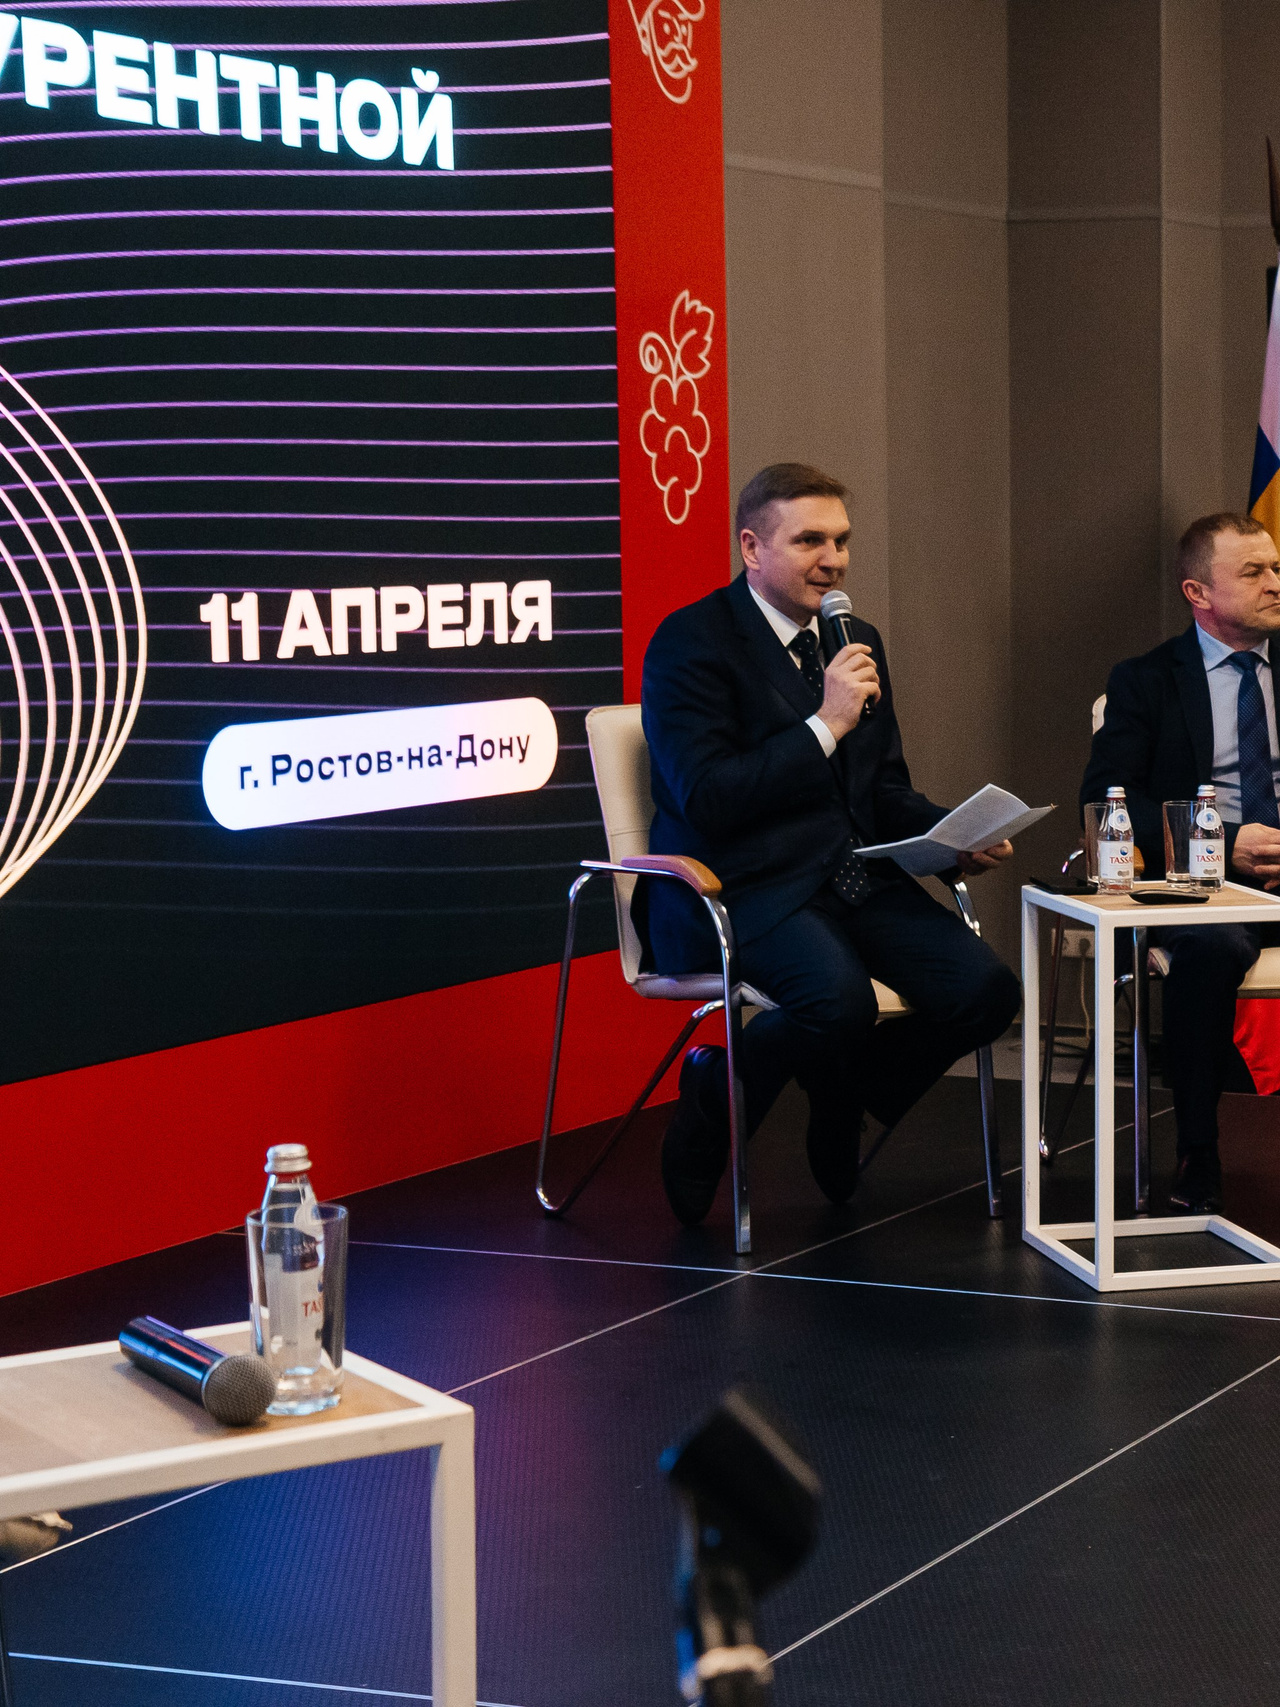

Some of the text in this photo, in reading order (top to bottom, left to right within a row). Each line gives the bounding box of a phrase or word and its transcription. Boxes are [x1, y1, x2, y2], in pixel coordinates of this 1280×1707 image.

[200, 580, 553, 663] 11 АПРЕЛЯ
[239, 734, 531, 790] г. Ростов-на-Дону
